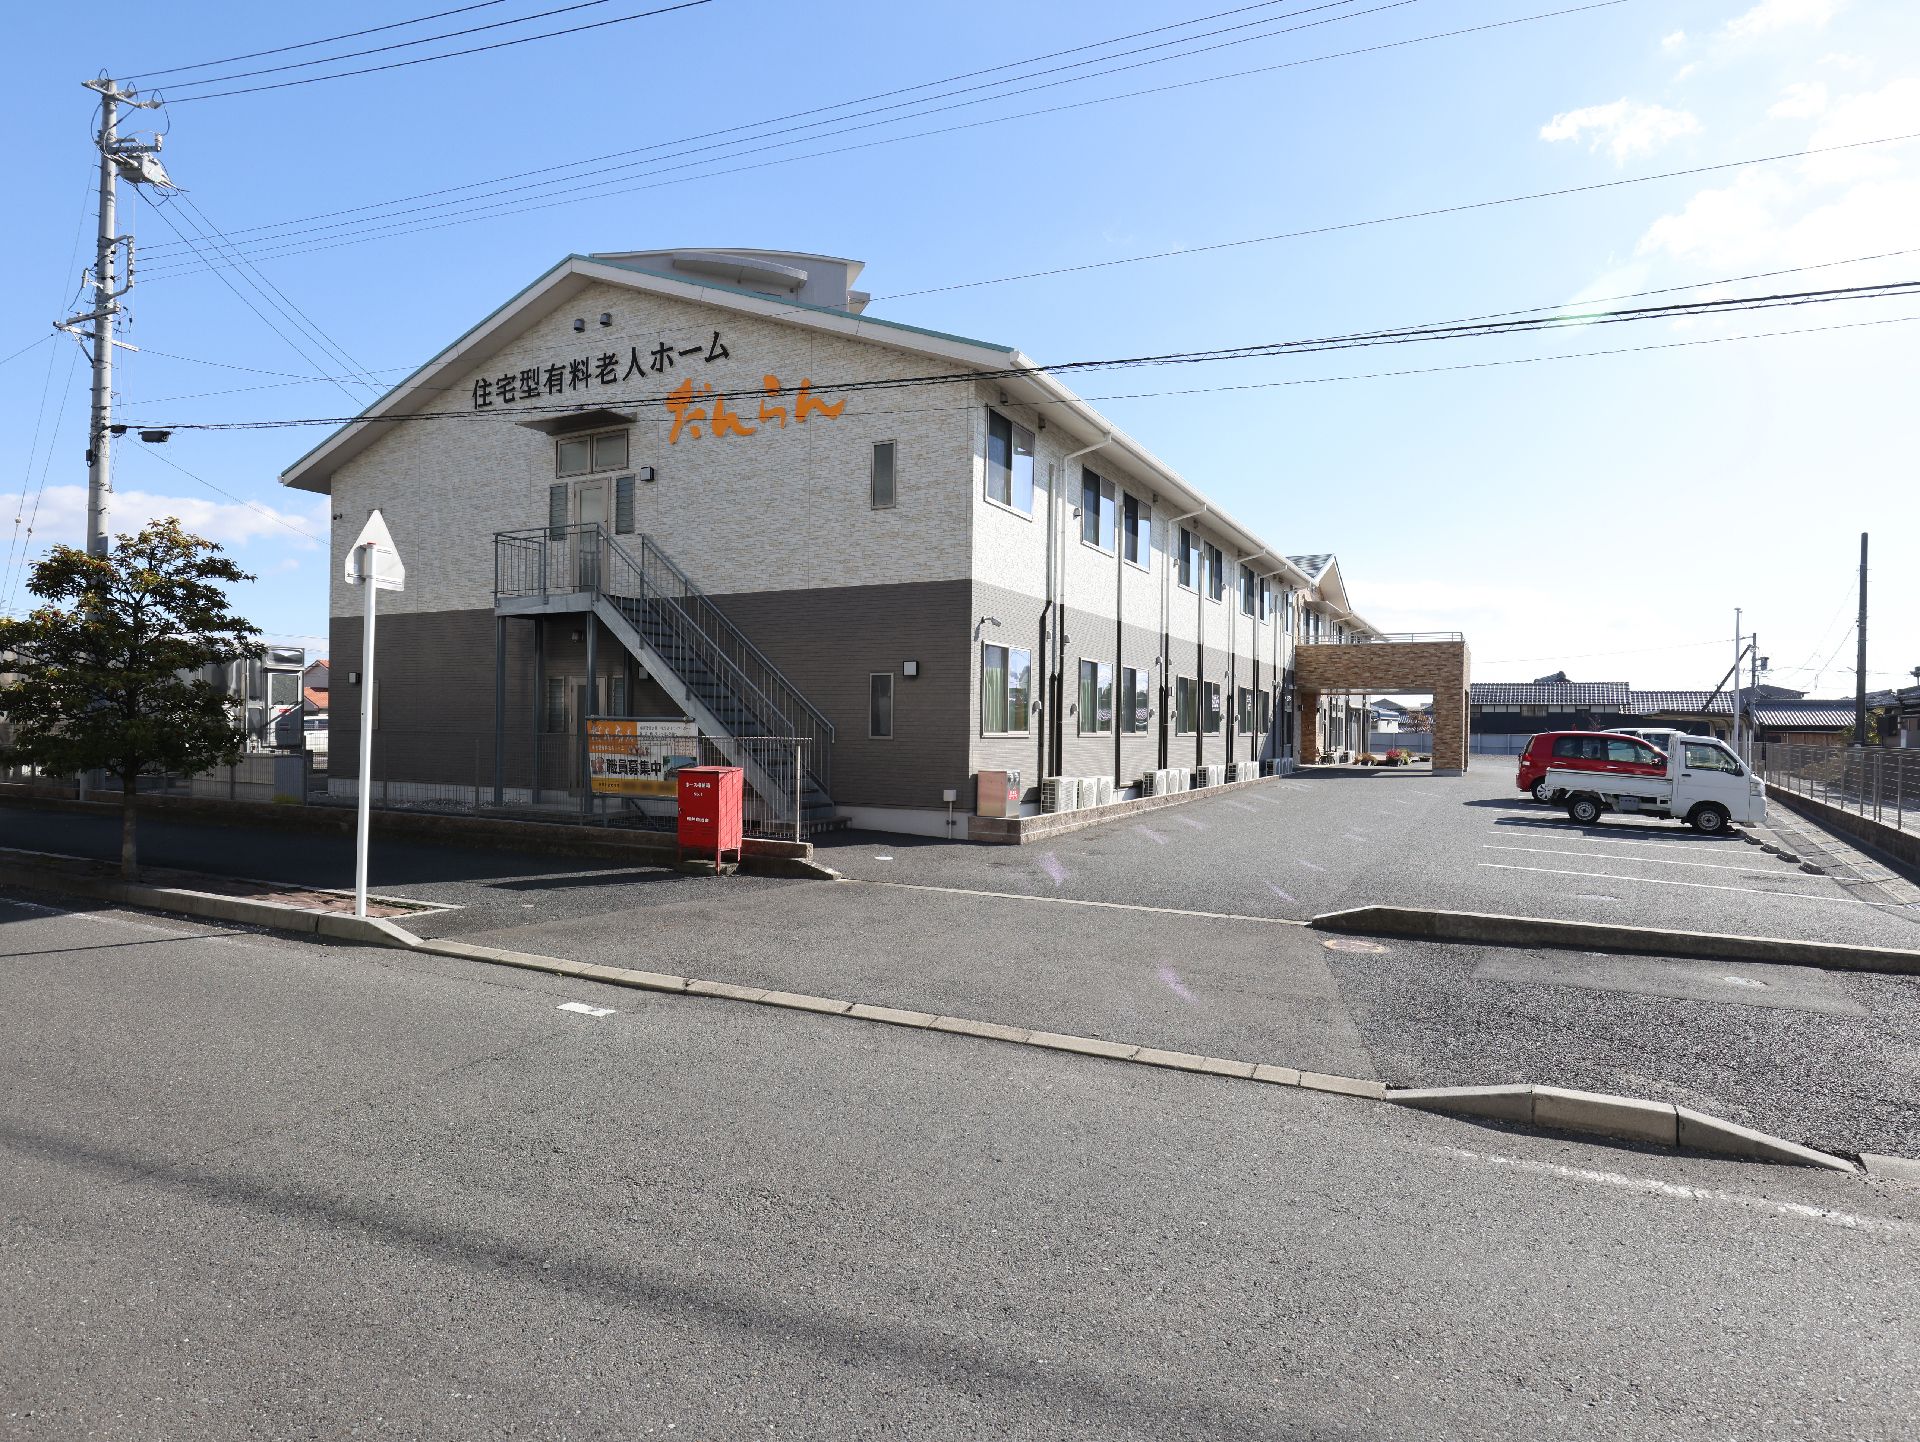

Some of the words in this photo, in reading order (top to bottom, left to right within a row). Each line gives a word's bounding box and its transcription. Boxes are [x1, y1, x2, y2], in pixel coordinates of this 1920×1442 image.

[472, 331, 731, 410] 住宅型有料老人ホーム
[664, 374, 847, 446] だんらん
[606, 758, 662, 777] 職員募集中
